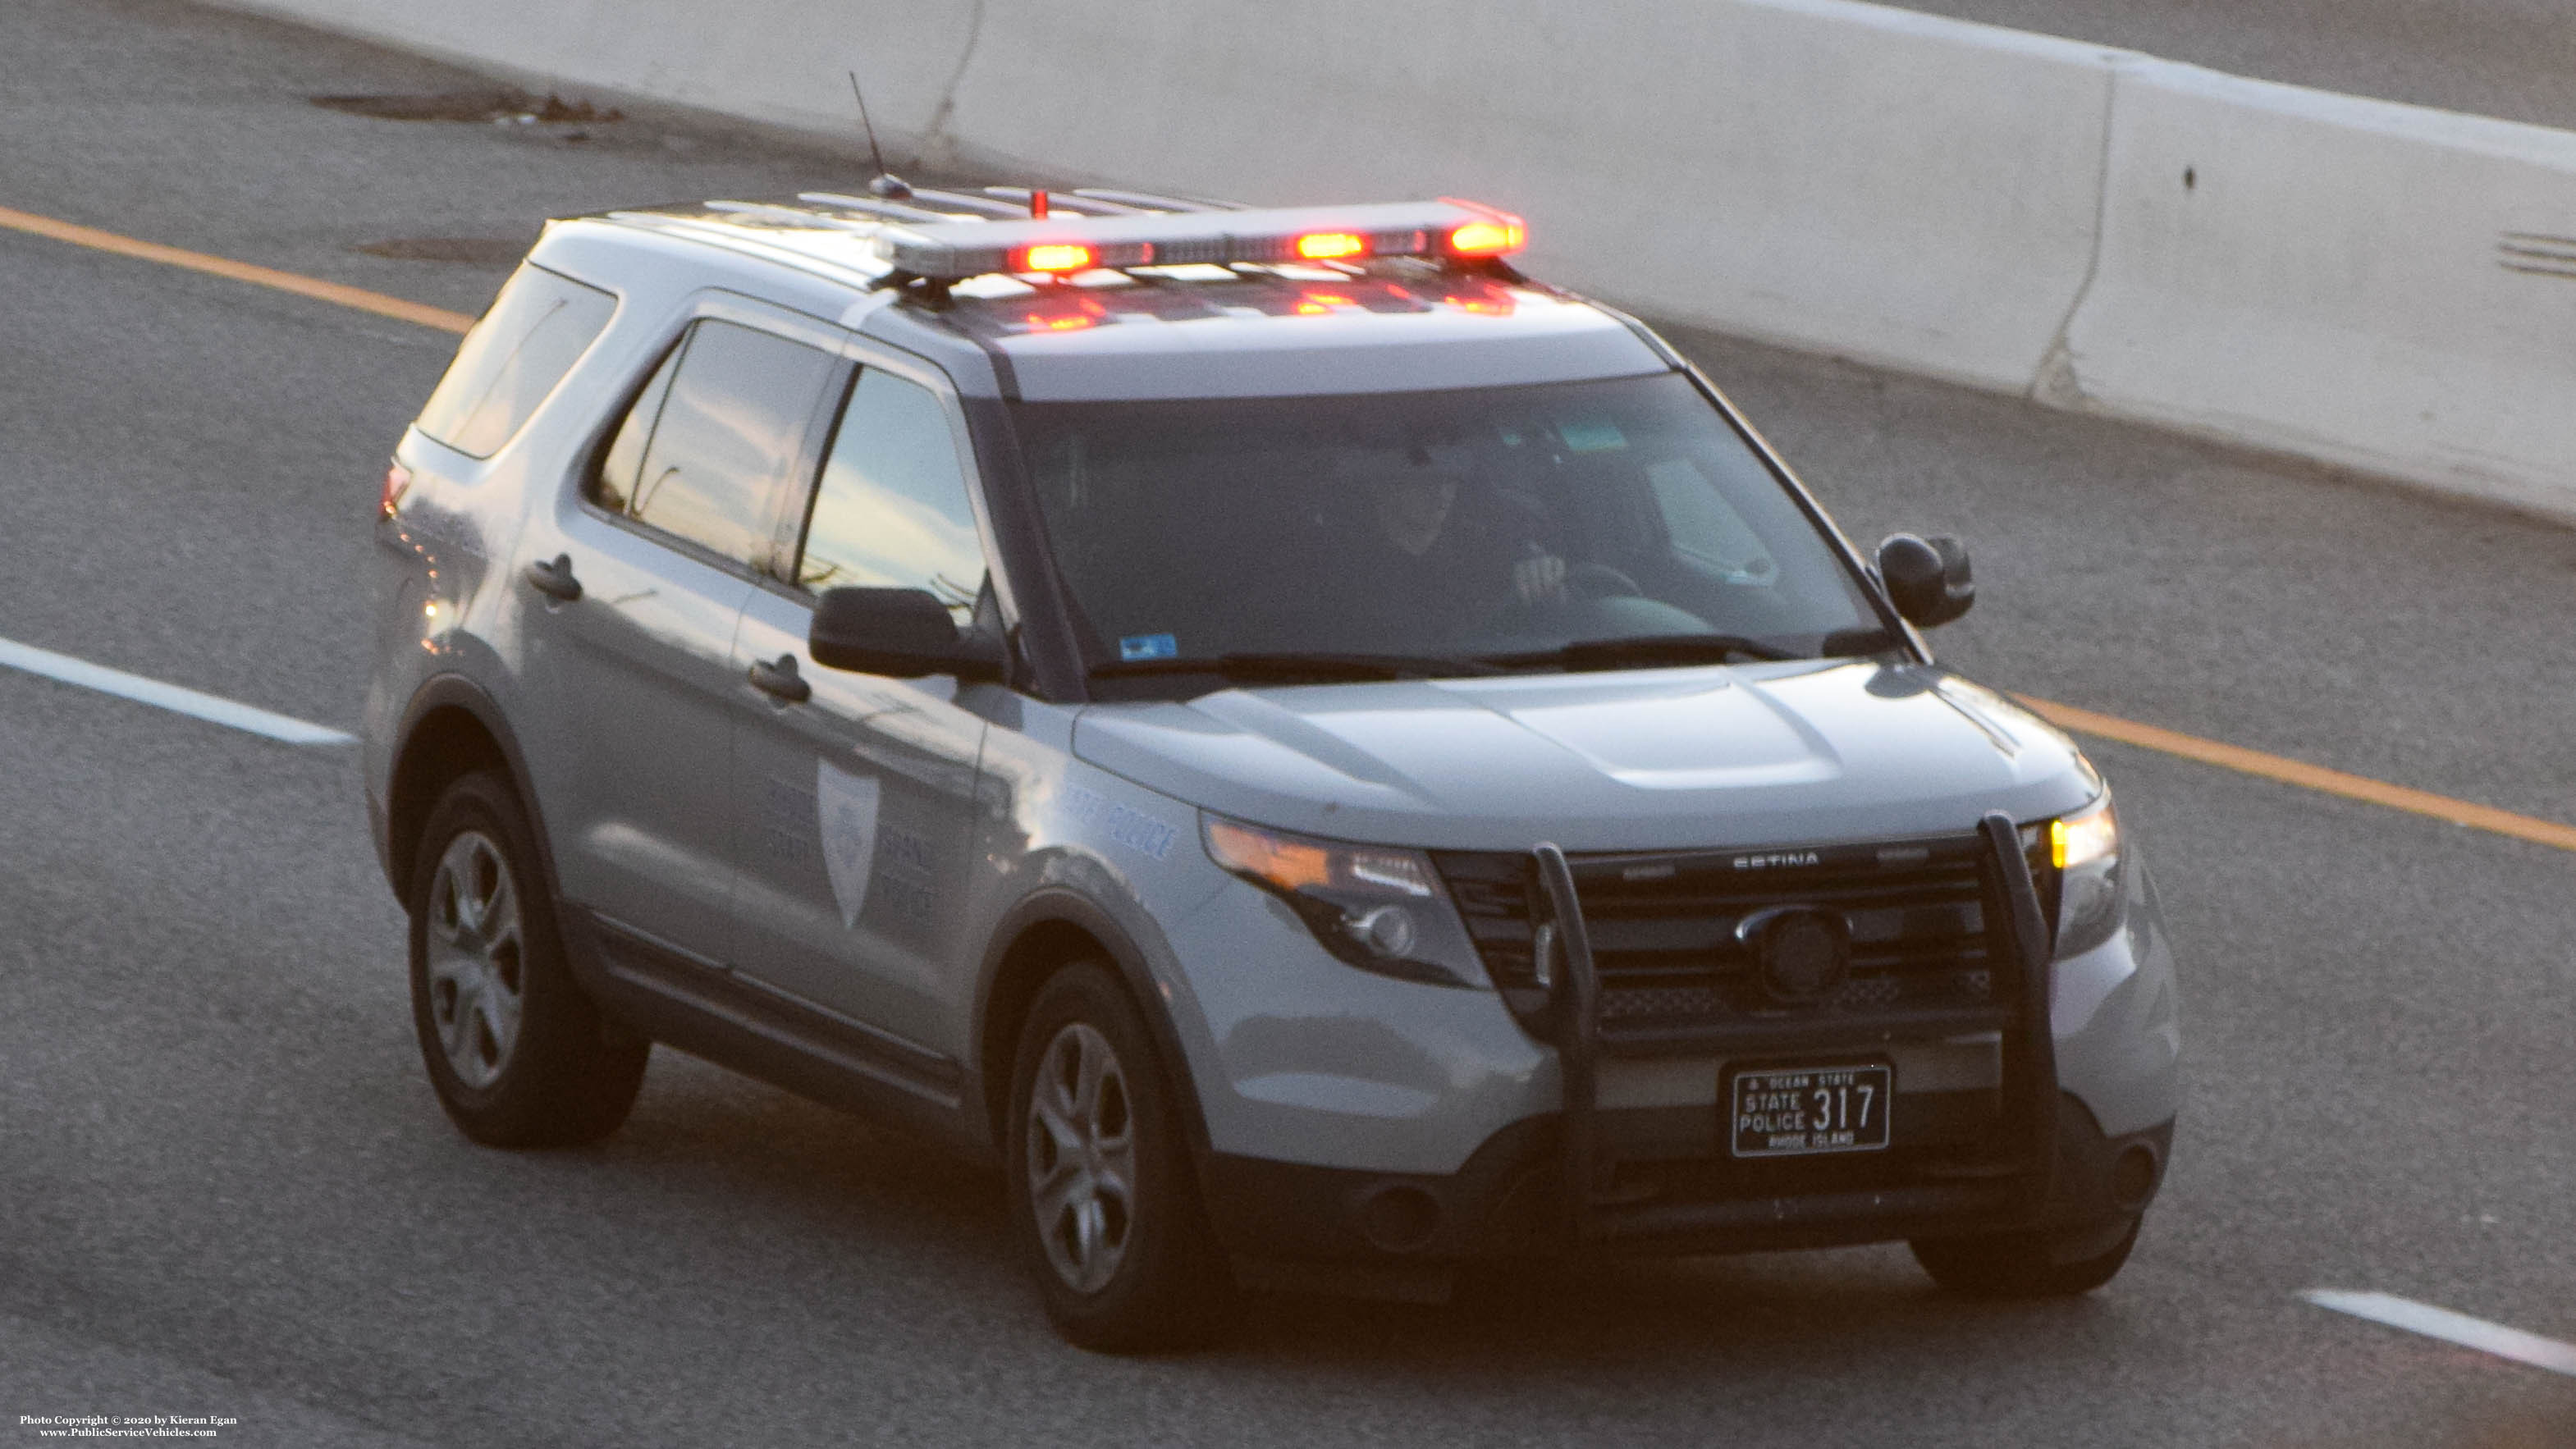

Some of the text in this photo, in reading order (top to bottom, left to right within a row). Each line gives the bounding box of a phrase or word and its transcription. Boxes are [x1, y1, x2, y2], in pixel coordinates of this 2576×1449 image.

[1769, 1073, 1855, 1090] OCEAN STATE
[1746, 1092, 1801, 1113] STATE
[1813, 1085, 1874, 1131] 317
[1740, 1111, 1805, 1133] POLICE
